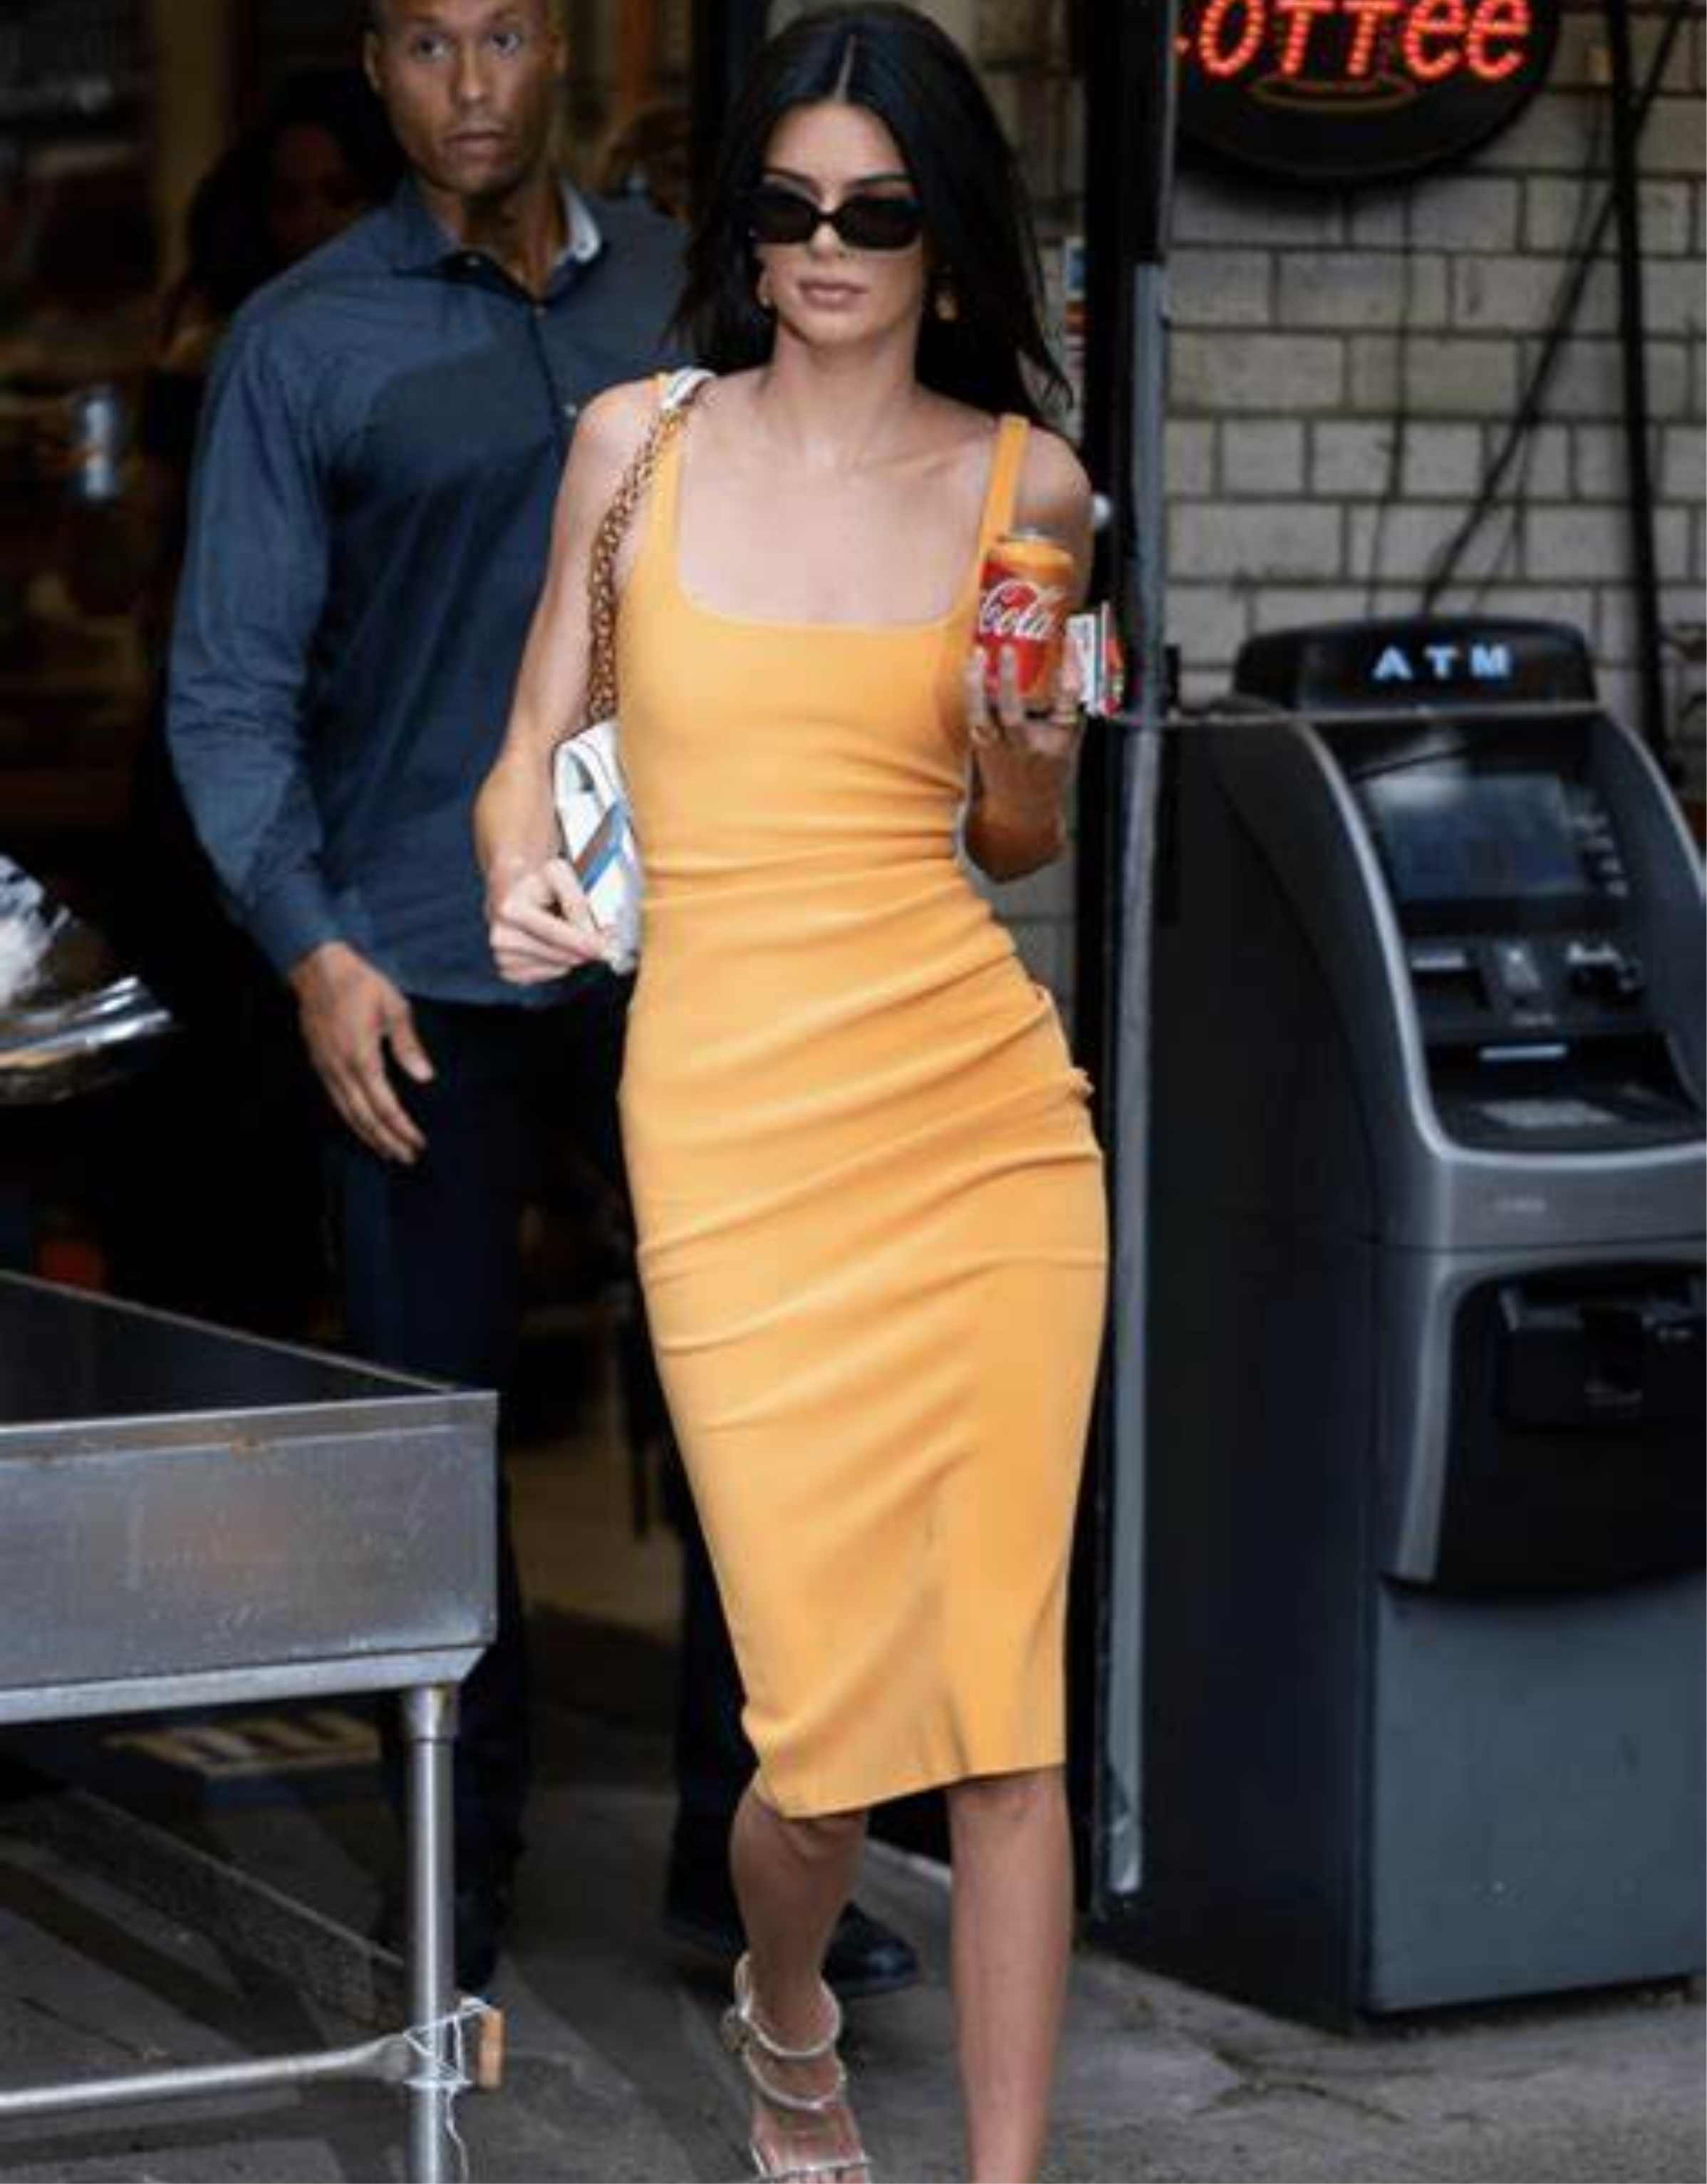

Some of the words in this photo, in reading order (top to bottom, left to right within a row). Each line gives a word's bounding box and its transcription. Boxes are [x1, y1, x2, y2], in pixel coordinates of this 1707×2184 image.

[1177, 0, 1530, 78] offee
[979, 579, 1052, 641] Cola
[1373, 643, 1510, 680] ATM
